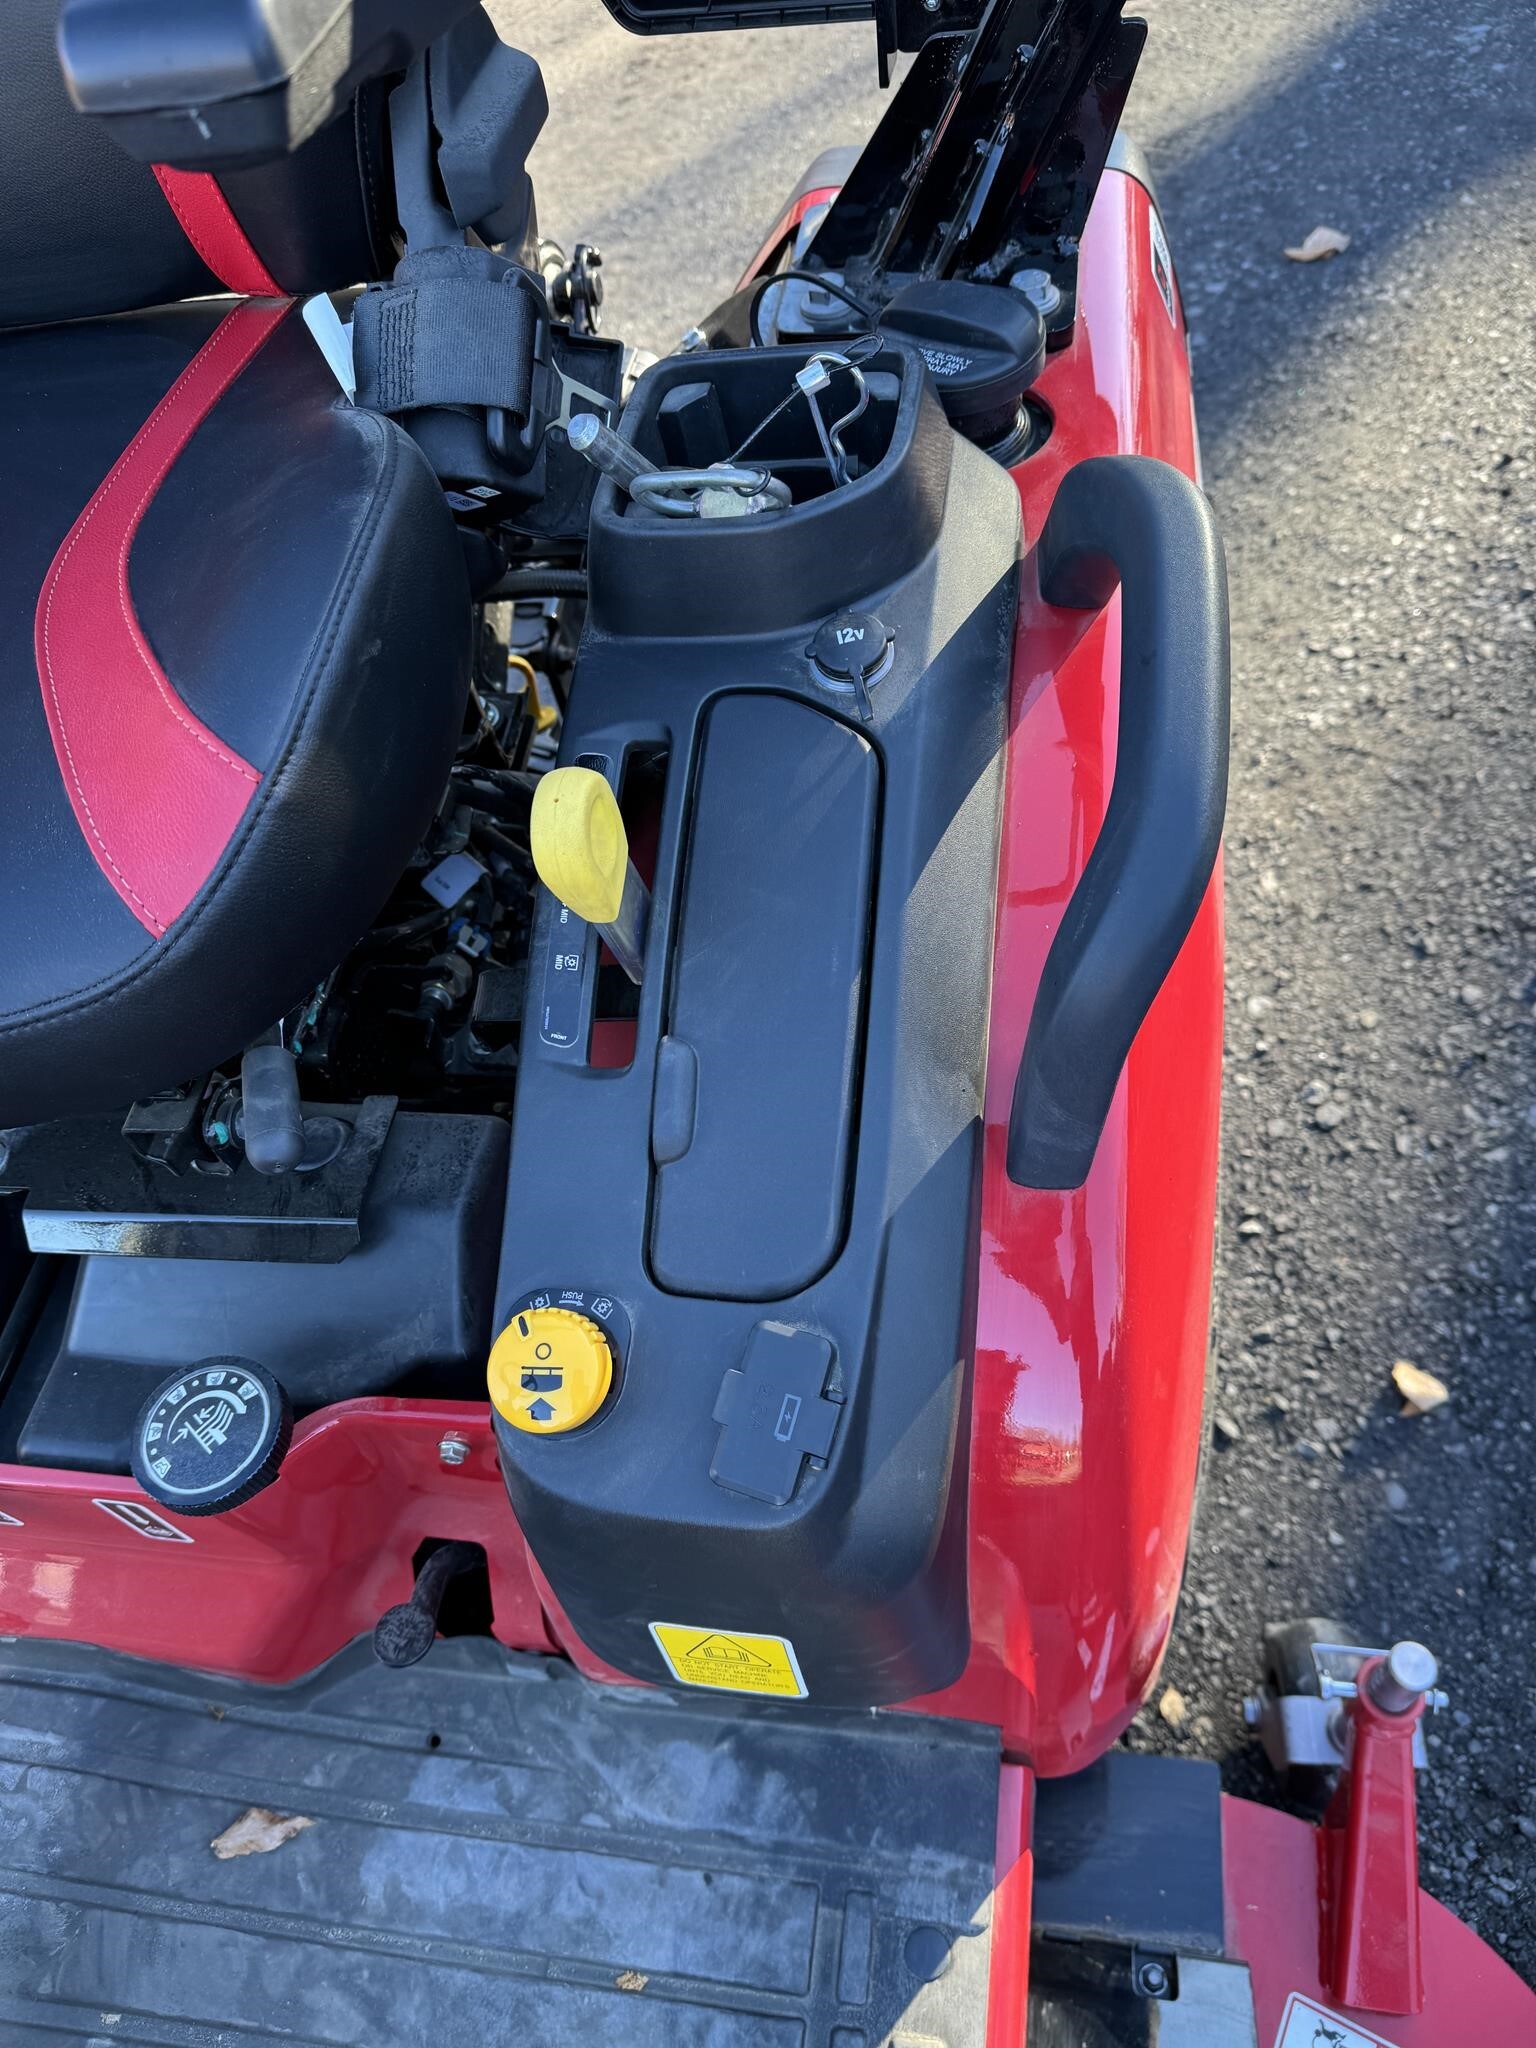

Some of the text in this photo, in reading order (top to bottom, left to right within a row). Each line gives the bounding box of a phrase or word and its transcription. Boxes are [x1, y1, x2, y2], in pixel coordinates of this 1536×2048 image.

[946, 361, 967, 372] MAY
[554, 954, 563, 970] MID
[561, 1291, 584, 1300] PUSH
